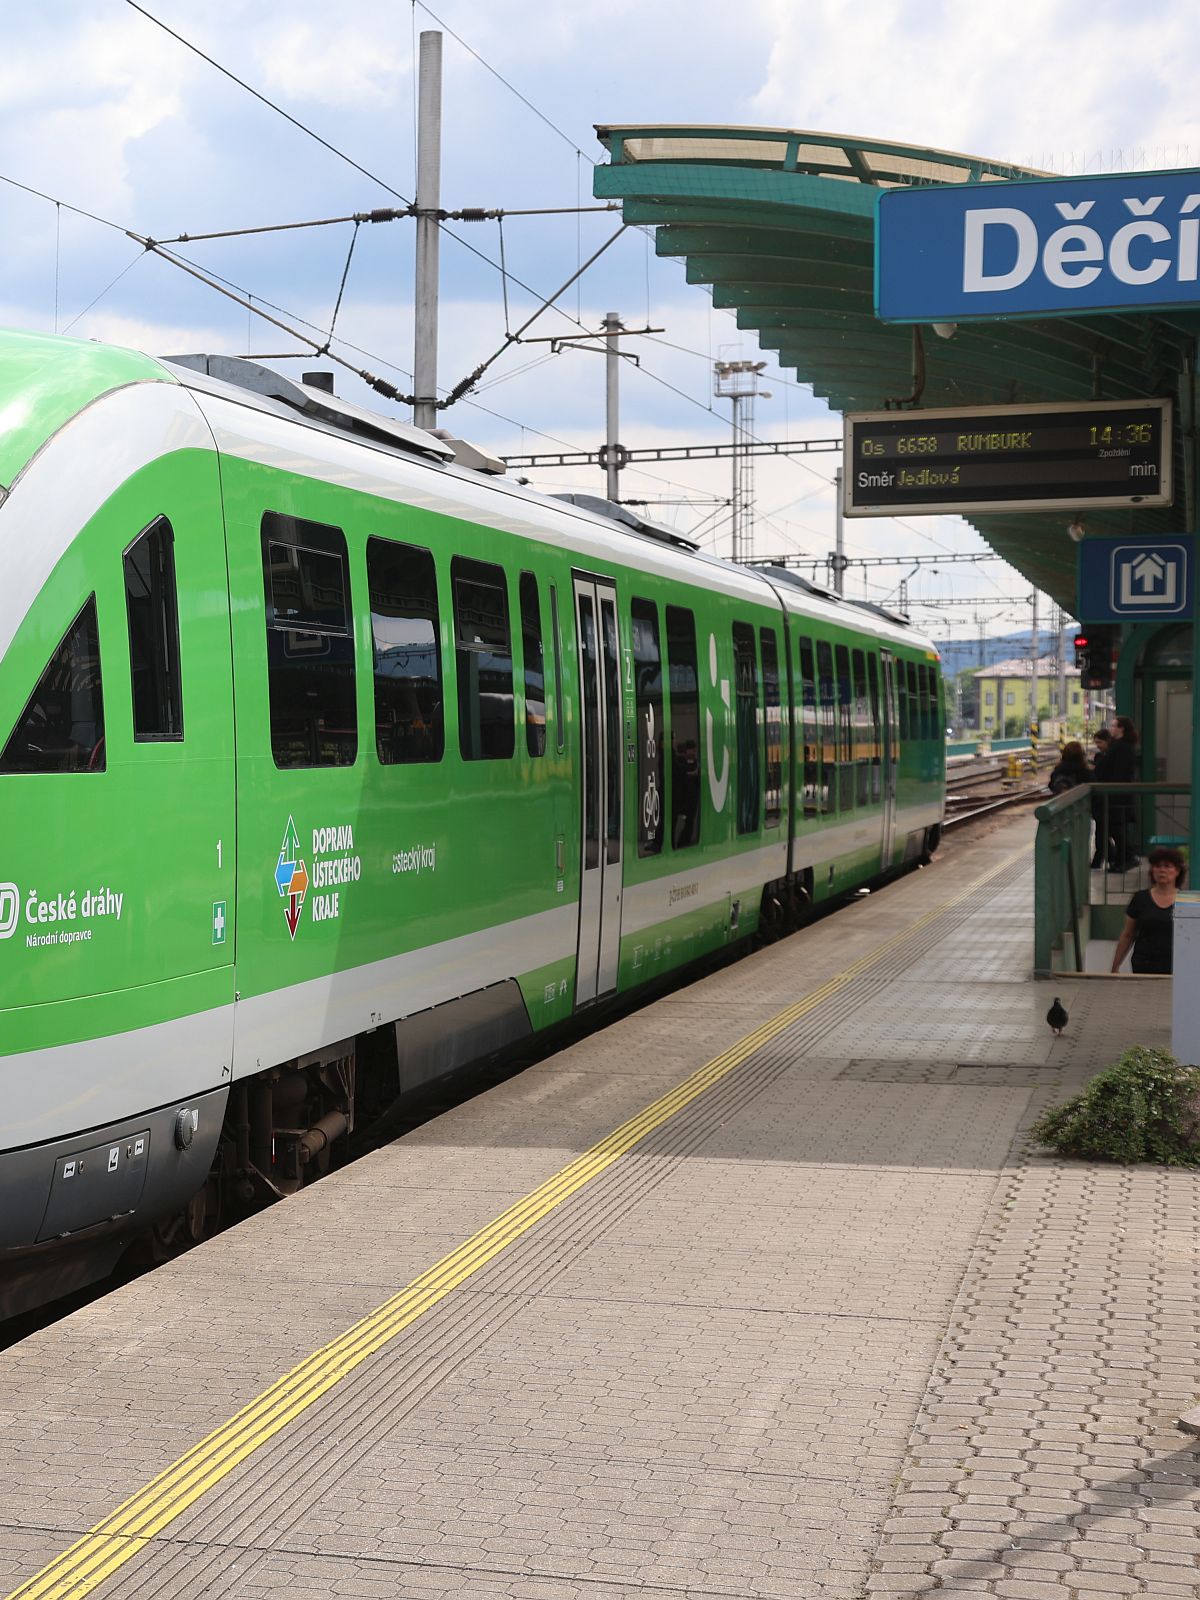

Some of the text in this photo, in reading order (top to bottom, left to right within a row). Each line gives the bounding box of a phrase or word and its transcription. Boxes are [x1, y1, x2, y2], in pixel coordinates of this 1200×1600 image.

[963, 193, 1200, 293] Děčí
[861, 424, 1152, 455] Os 6658 RUMBURK 14:36
[858, 466, 960, 487] Směr Jedlová
[313, 825, 353, 854] DOPRAVA
[313, 851, 360, 888] ÚSTECKÉHO
[421, 842, 436, 872] kraj
[25, 886, 124, 924] České dráhy
[313, 893, 338, 922] KRAJE
[26, 929, 92, 948] Národní dopravce
